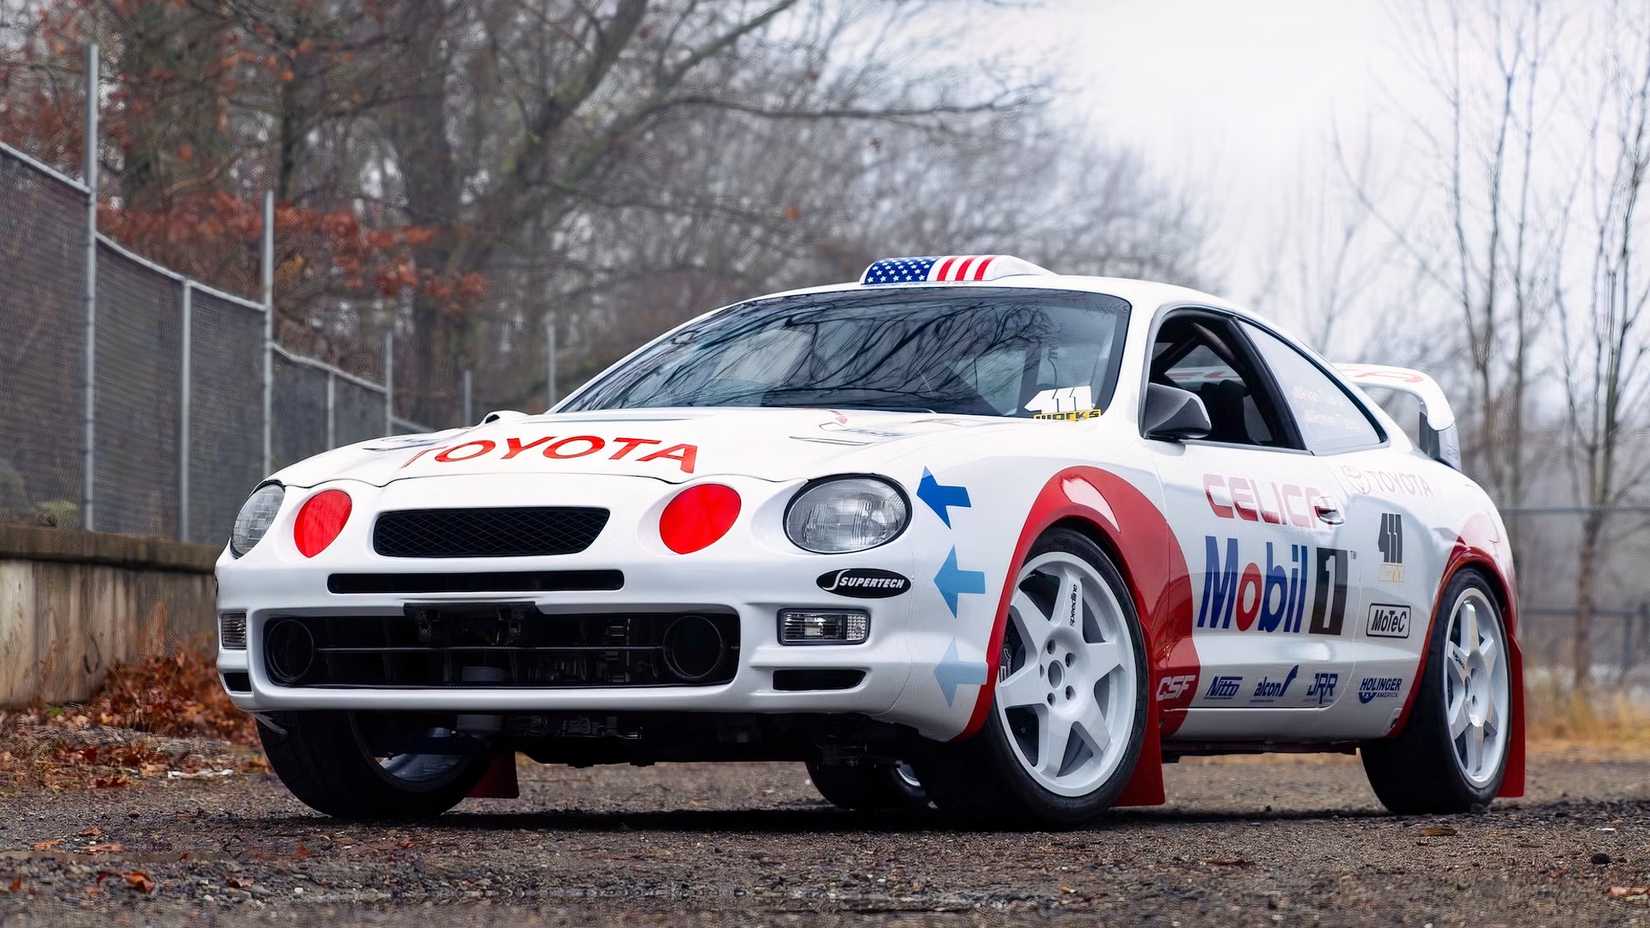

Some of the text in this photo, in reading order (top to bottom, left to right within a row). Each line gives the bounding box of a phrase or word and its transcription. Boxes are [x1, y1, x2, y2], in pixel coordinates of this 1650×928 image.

[401, 435, 698, 474] TOYOTA
[838, 576, 905, 589] SUPERTECH
[1197, 536, 1308, 633] Mobil
[1371, 608, 1407, 633] MoTeC
[1156, 675, 1196, 701] CSF
[1205, 676, 1243, 697] Nitto
[1306, 673, 1338, 704] JRR
[1360, 678, 1402, 691] HOLINGER
